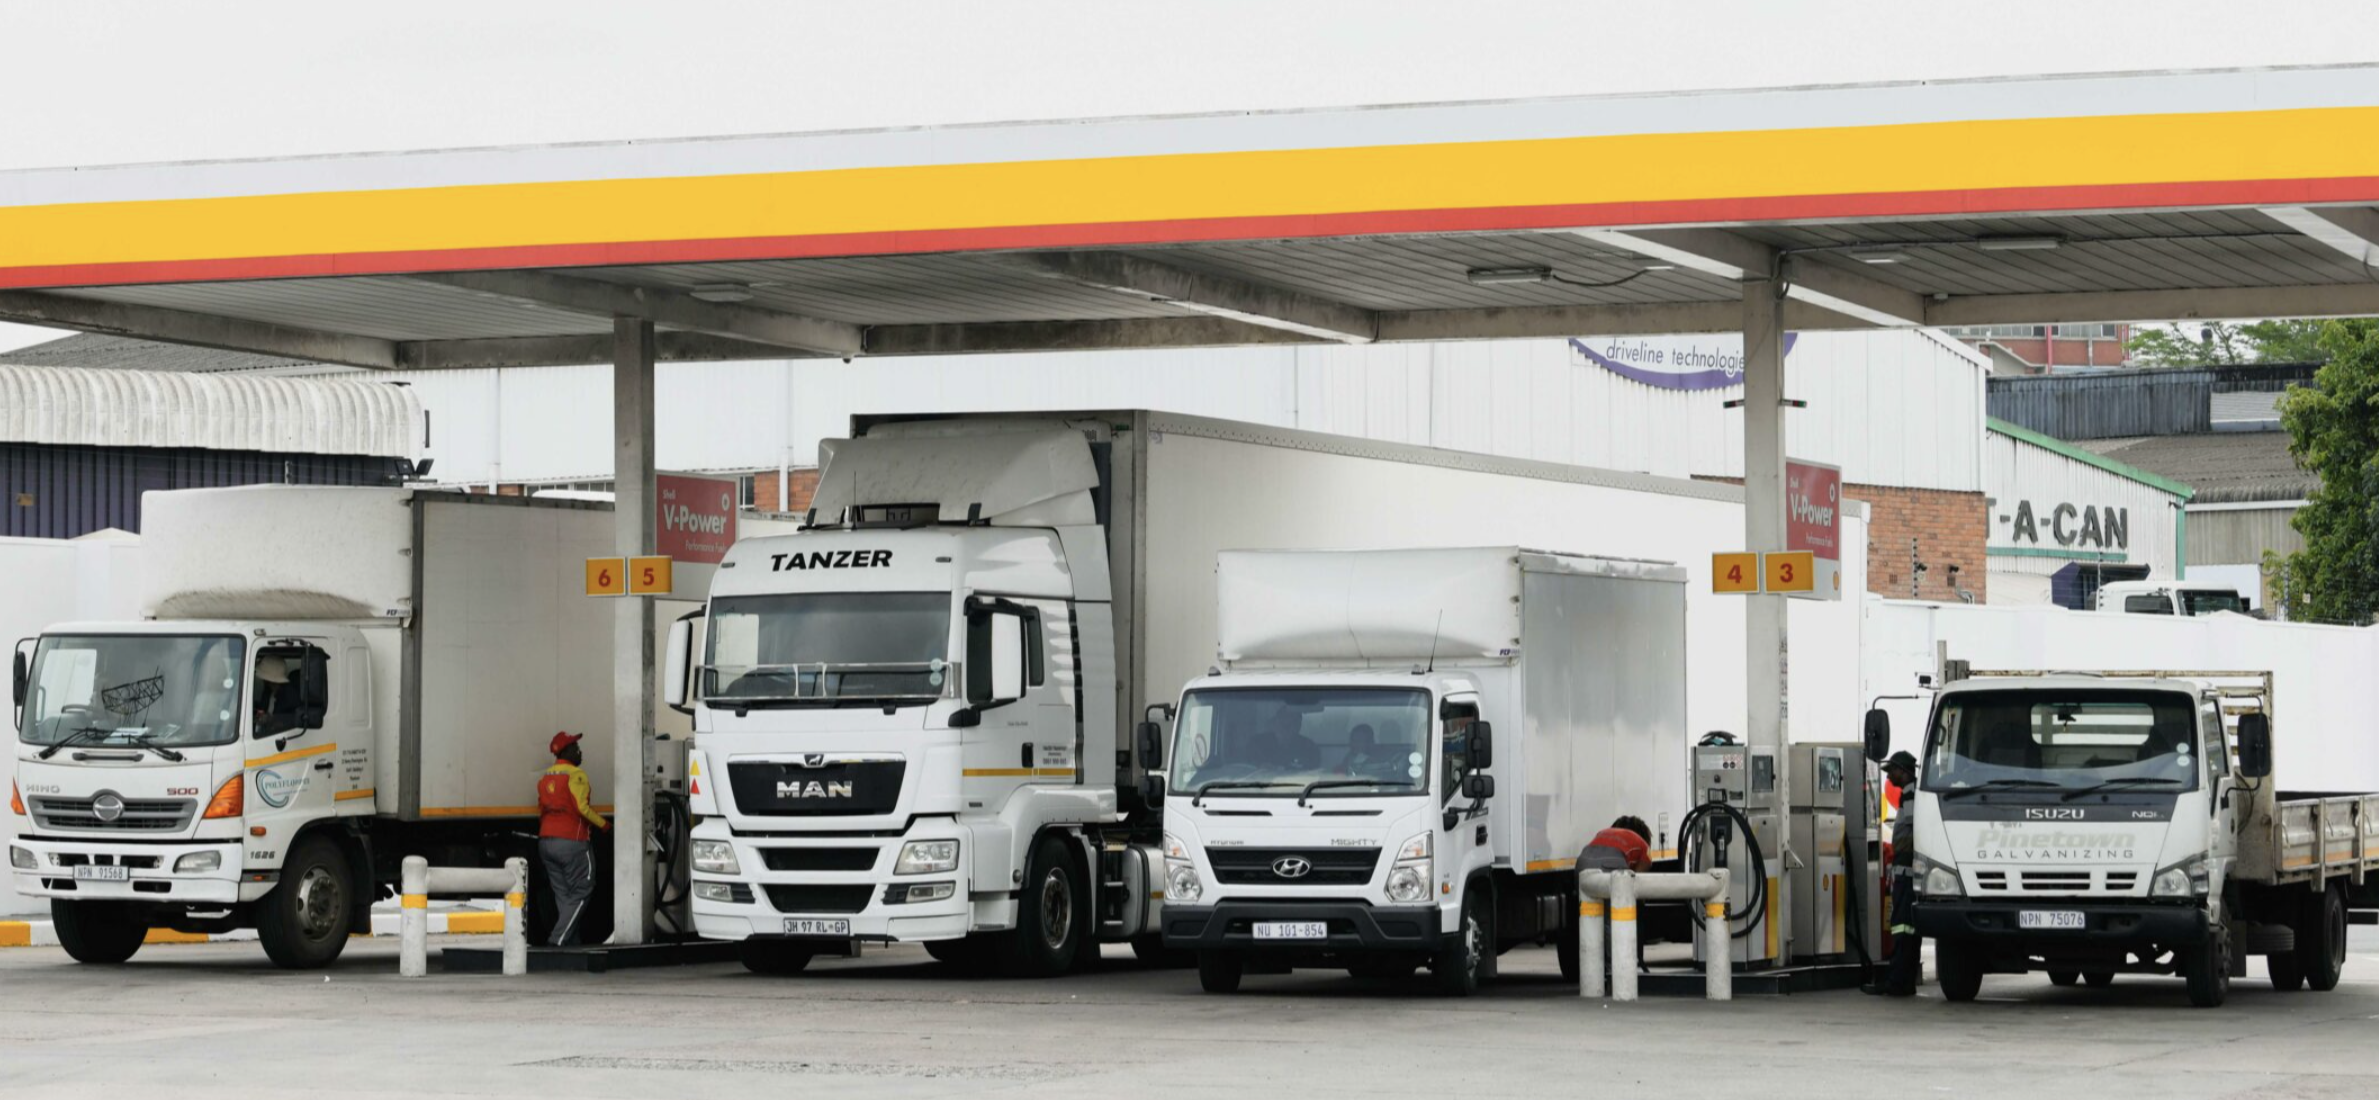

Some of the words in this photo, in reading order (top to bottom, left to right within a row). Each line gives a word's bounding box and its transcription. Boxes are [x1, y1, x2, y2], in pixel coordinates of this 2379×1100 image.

[1606, 339, 1663, 364] driveline
[1671, 346, 1744, 374] technologie
[662, 489, 675, 499] Shell
[1790, 493, 1833, 527] V-Power
[663, 504, 727, 534] V-Power
[771, 549, 893, 572] TANZER
[598, 569, 611, 587] 6
[642, 568, 655, 586] 5
[1727, 564, 1742, 584] 4
[1780, 563, 1794, 583] 3
[26, 784, 60, 793] HINO
[166, 787, 199, 796] 500
[777, 781, 852, 798] MAN
[2026, 808, 2085, 819] ISUZU
[1330, 838, 1377, 846] MIGHTY
[1976, 830, 2136, 848] Pinetown
[250, 851, 275, 859] 1626
[1977, 850, 2134, 859] GALVANIZING
[77, 869, 93, 878] NPN
[2020, 912, 2042, 925] NPN
[2050, 912, 2084, 926] 75076
[787, 921, 798, 933] JH
[801, 921, 812, 933] 97
[816, 921, 828, 933] RL
[834, 921, 846, 933] GP
[1257, 924, 1271, 936] NU
[1278, 924, 1324, 937] 101-854
